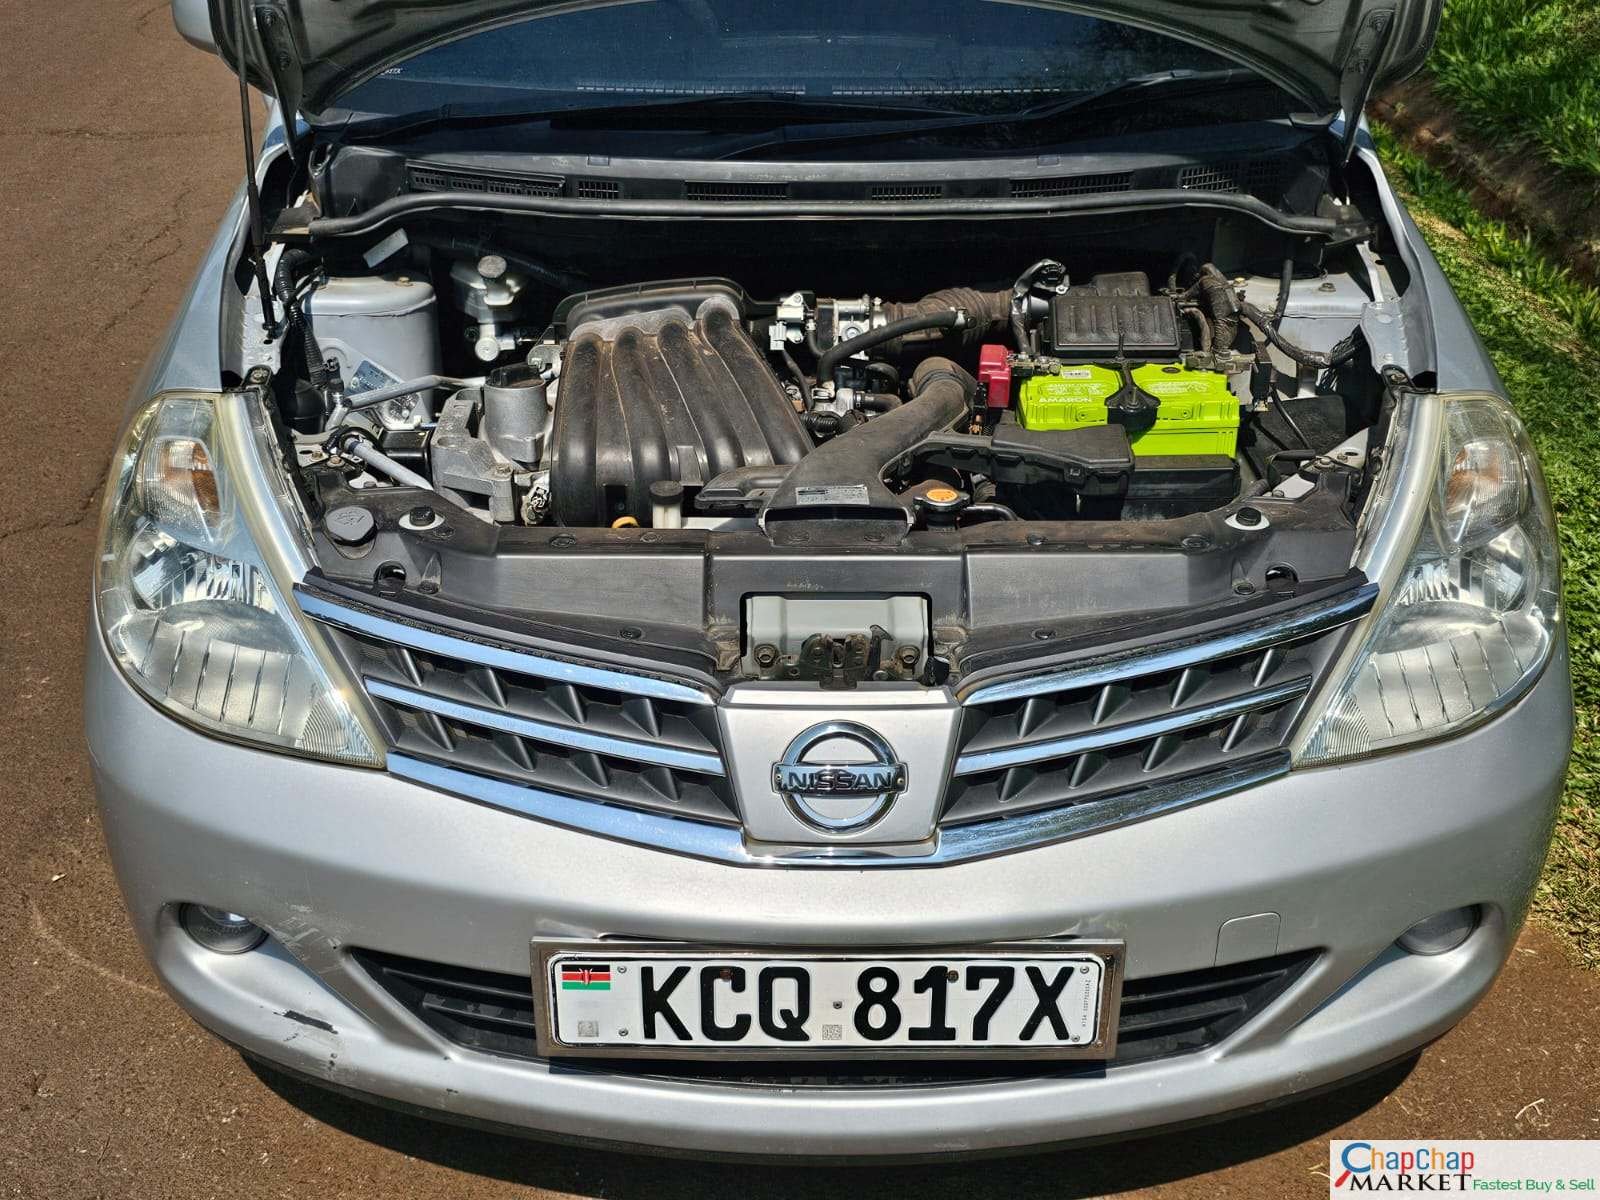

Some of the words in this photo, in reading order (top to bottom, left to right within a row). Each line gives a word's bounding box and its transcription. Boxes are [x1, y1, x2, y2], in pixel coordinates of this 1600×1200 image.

[788, 769, 892, 790] NISSAN
[640, 965, 811, 1041] KCQ
[853, 965, 1076, 1042] 817X
